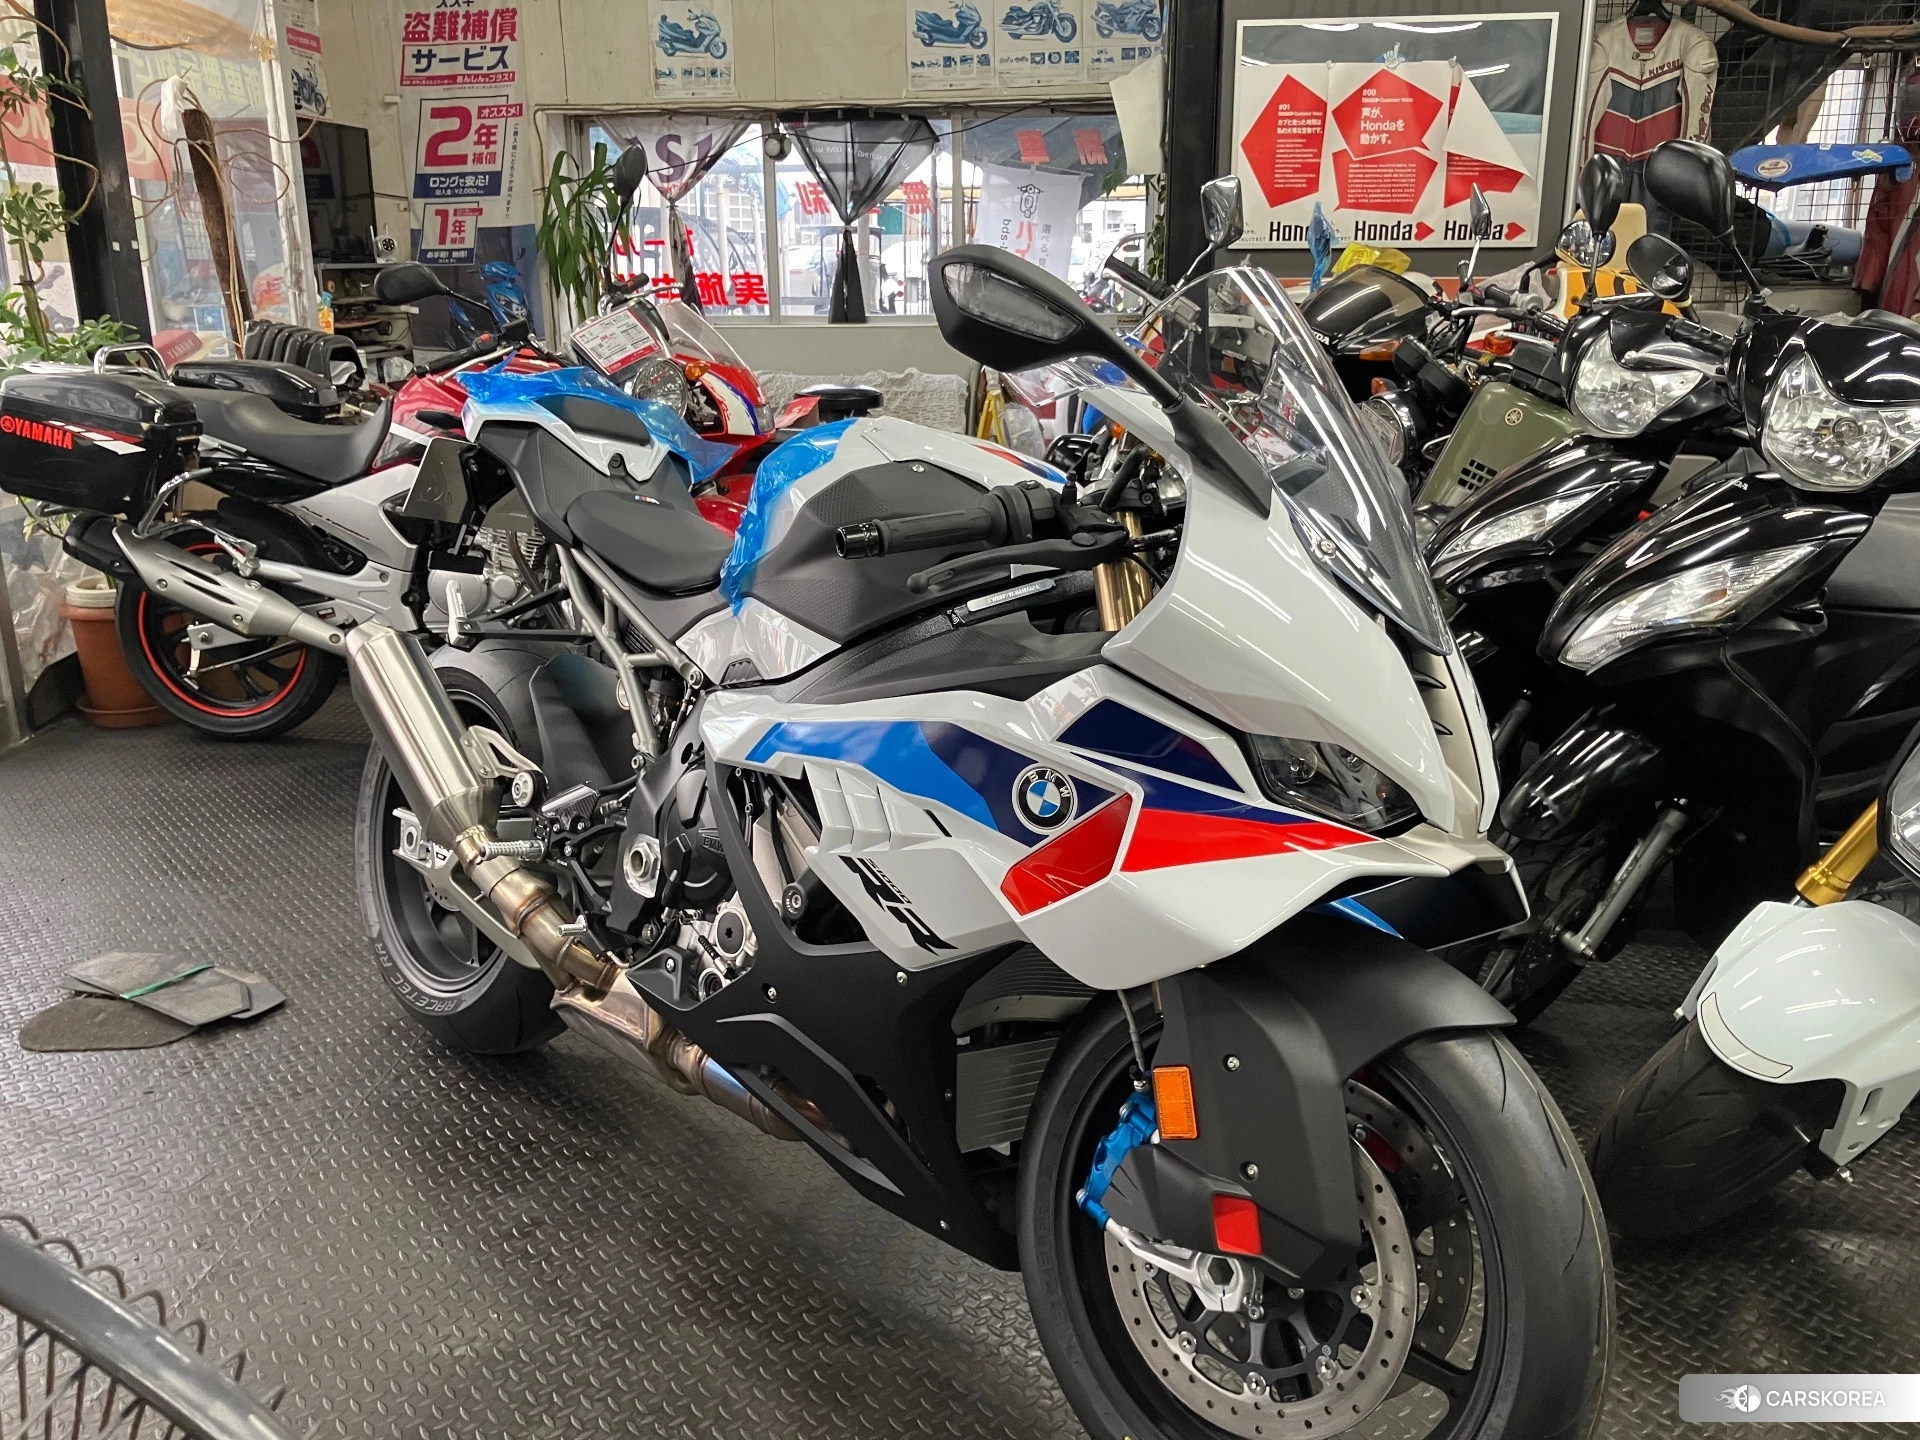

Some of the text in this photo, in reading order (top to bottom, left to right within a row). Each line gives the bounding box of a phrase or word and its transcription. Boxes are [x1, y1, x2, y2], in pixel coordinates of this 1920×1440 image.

[402, 8, 517, 42] 盗難補償
[412, 45, 509, 73] サービス
[481, 105, 520, 118] オススメ!
[1361, 107, 1383, 118] 声が、
[1360, 119, 1405, 131] Hondaを
[1360, 133, 1392, 144] 動かす。
[430, 175, 489, 188] ロングで安心!
[1354, 220, 1413, 241] Honda
[15, 418, 73, 449] YAMAHA
[1028, 770, 1070, 798] BMW
[838, 855, 958, 956] RR
[375, 943, 457, 1011] RACETEC RR
